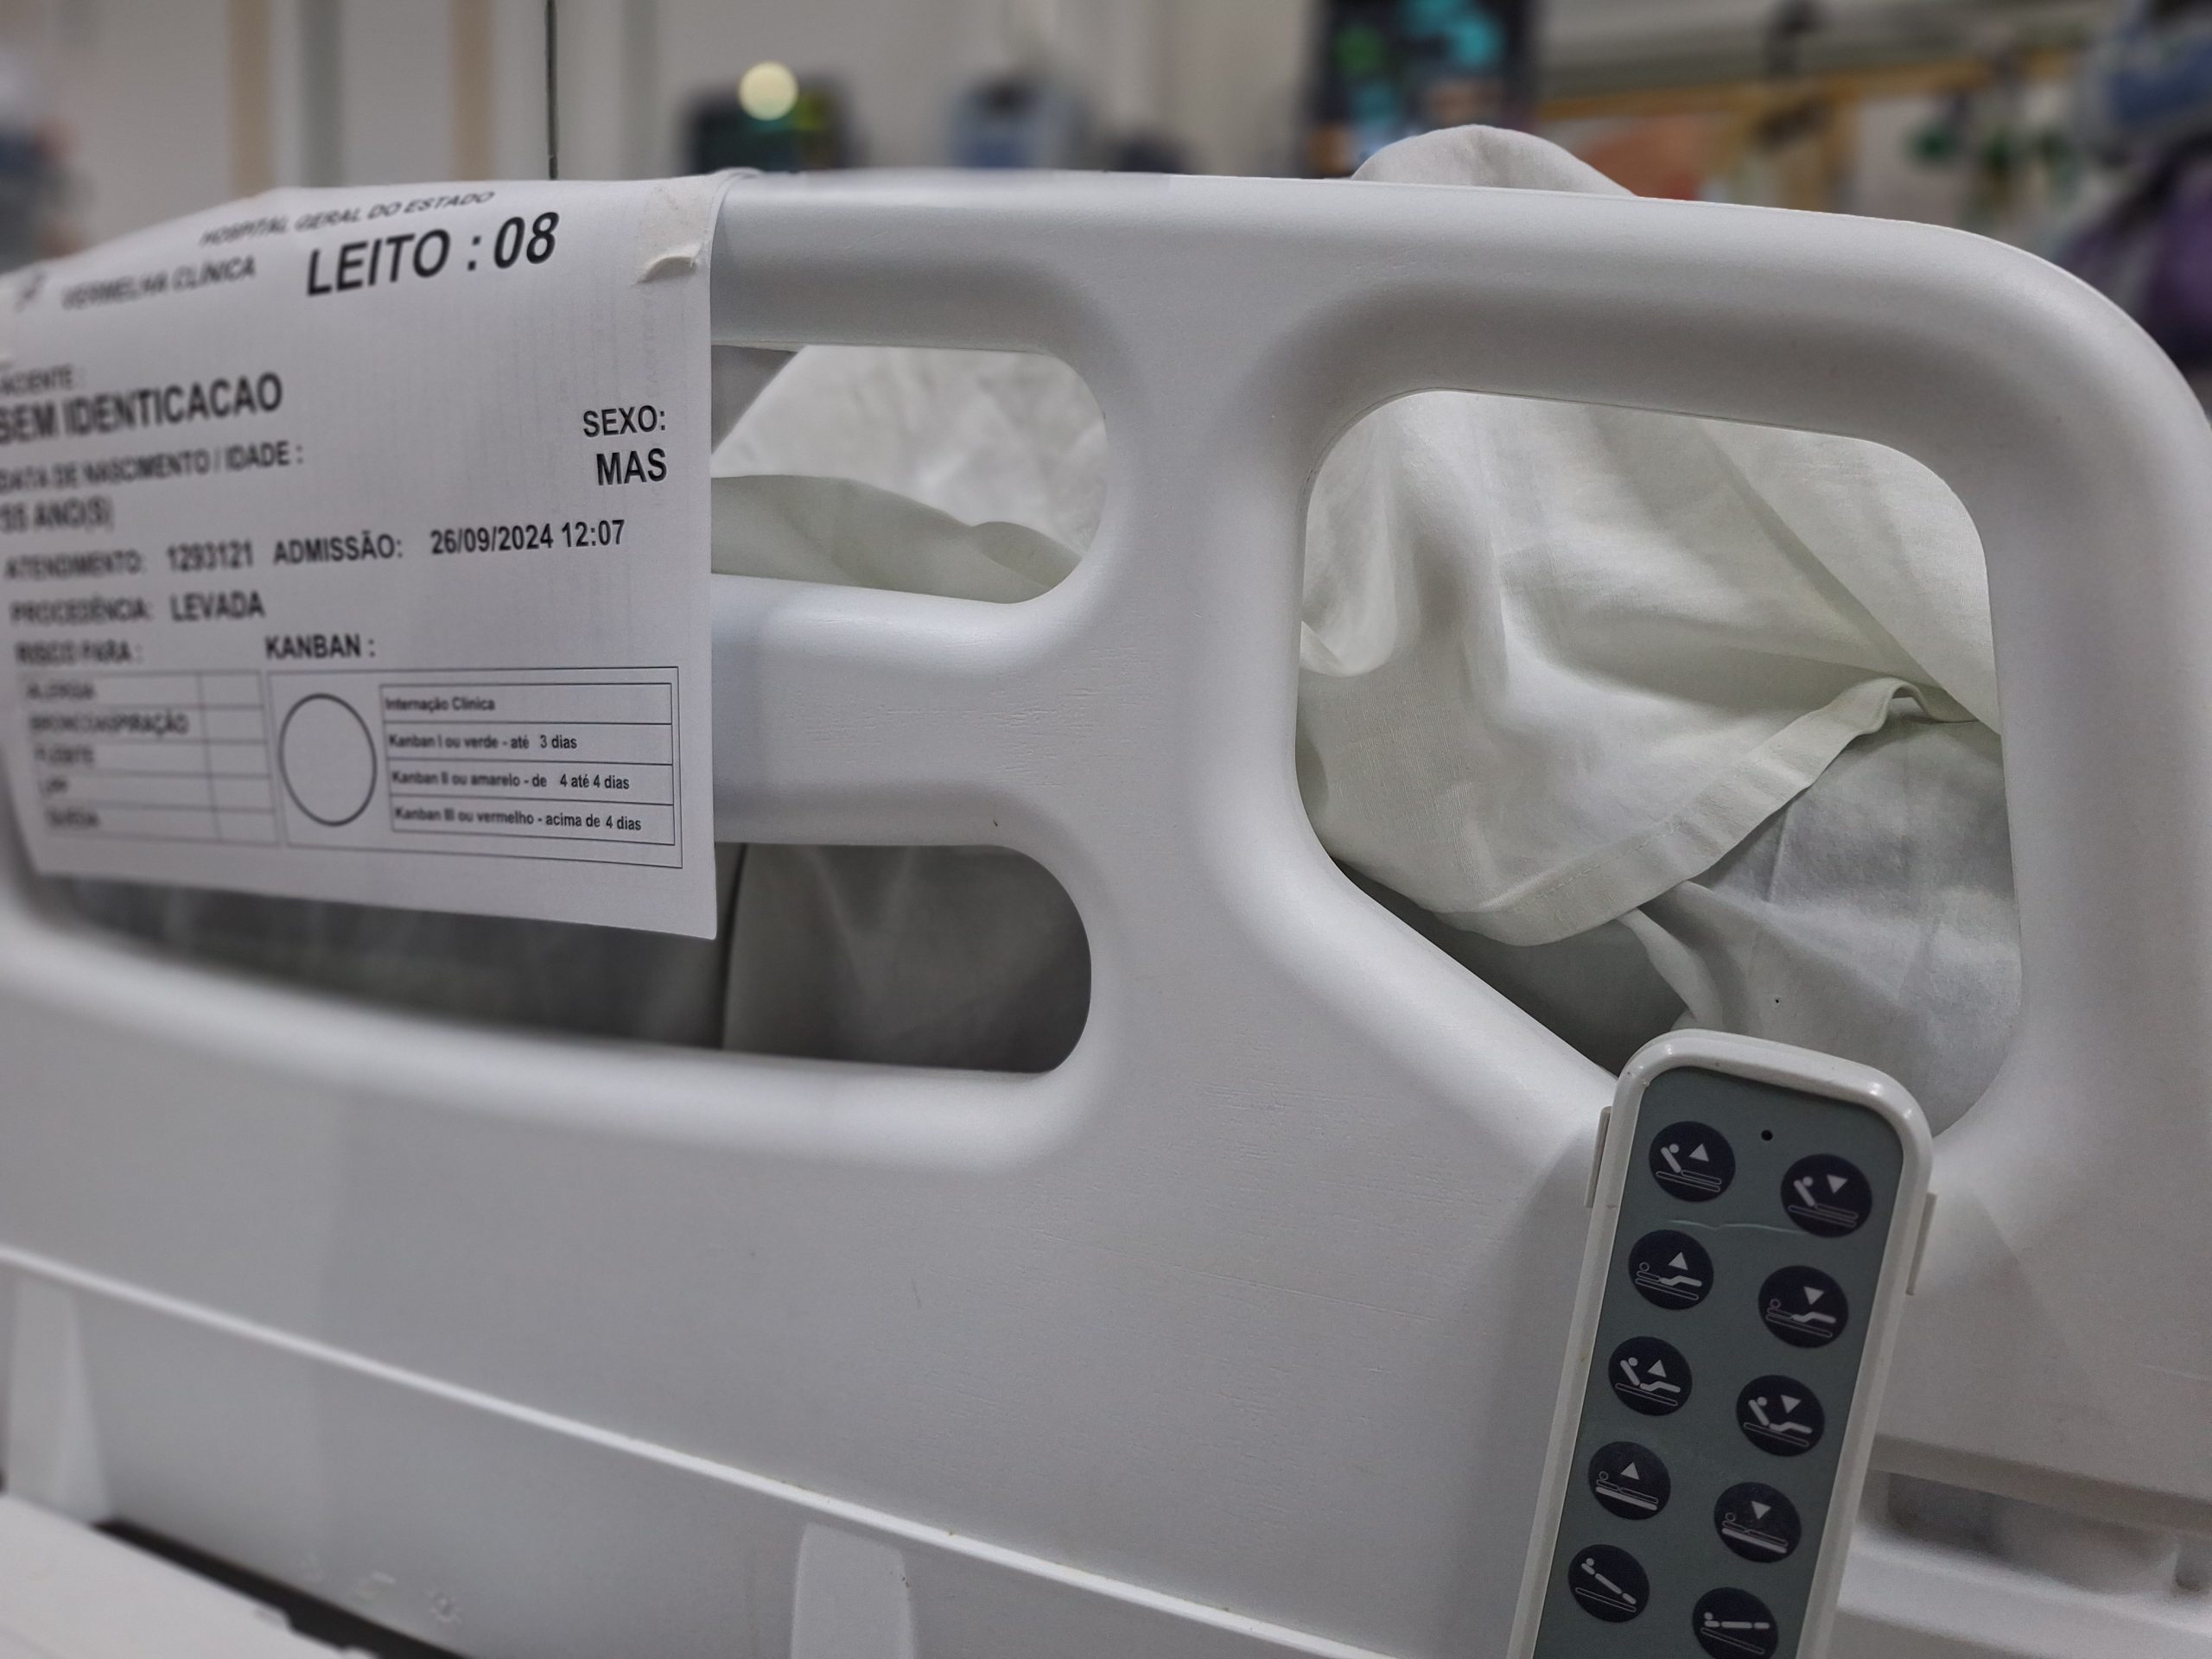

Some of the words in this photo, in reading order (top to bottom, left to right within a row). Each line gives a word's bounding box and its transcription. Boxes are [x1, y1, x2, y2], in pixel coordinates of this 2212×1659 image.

[199, 215, 289, 246] HOSPITAL
[295, 207, 361, 232] GERAL
[366, 201, 403, 219] DO
[404, 191, 495, 214] ESTADO
[306, 228, 451, 296] LEITO
[467, 235, 481, 271] :
[493, 212, 559, 270] 08
[0, 400, 56, 446] SEM
[63, 372, 283, 435] IDENTICACAO
[583, 404, 666, 437] SEXO:
[52, 461, 78, 489] DE
[83, 449, 212, 486] NASCIMENTO
[225, 441, 289, 474] IDADE
[596, 448, 668, 487] MAS
[168, 540, 254, 573] 1293121
[273, 531, 403, 565] ADMISSÃO:
[430, 524, 554, 555] 26/09/2024
[562, 519, 625, 548] 12:07
[170, 592, 265, 623] LEVADA
[264, 633, 362, 659] KANBAN
[385, 696, 449, 714] Internação
[389, 734, 435, 749] Kanban
[445, 738, 461, 749] ou
[464, 734, 499, 749] verde
[511, 734, 530, 749] até
[539, 734, 548, 749] 3
[551, 734, 578, 749] dias
[392, 771, 439, 785] Kanban
[441, 771, 449, 785] II
[452, 775, 468, 785] ou
[470, 772, 521, 787] amarelo
[532, 773, 548, 788] de
[560, 773, 569, 788] 4
[571, 774, 590, 788] até
[593, 774, 601, 789] 4
[605, 775, 630, 790] dias
[395, 807, 442, 822] Kanban
[444, 807, 455, 822] III
[458, 811, 474, 822] ou
[477, 810, 535, 825] vermelho
[545, 812, 582, 827] acima
[586, 813, 601, 828] de
[606, 815, 613, 830] 4
[617, 816, 642, 831] dias
